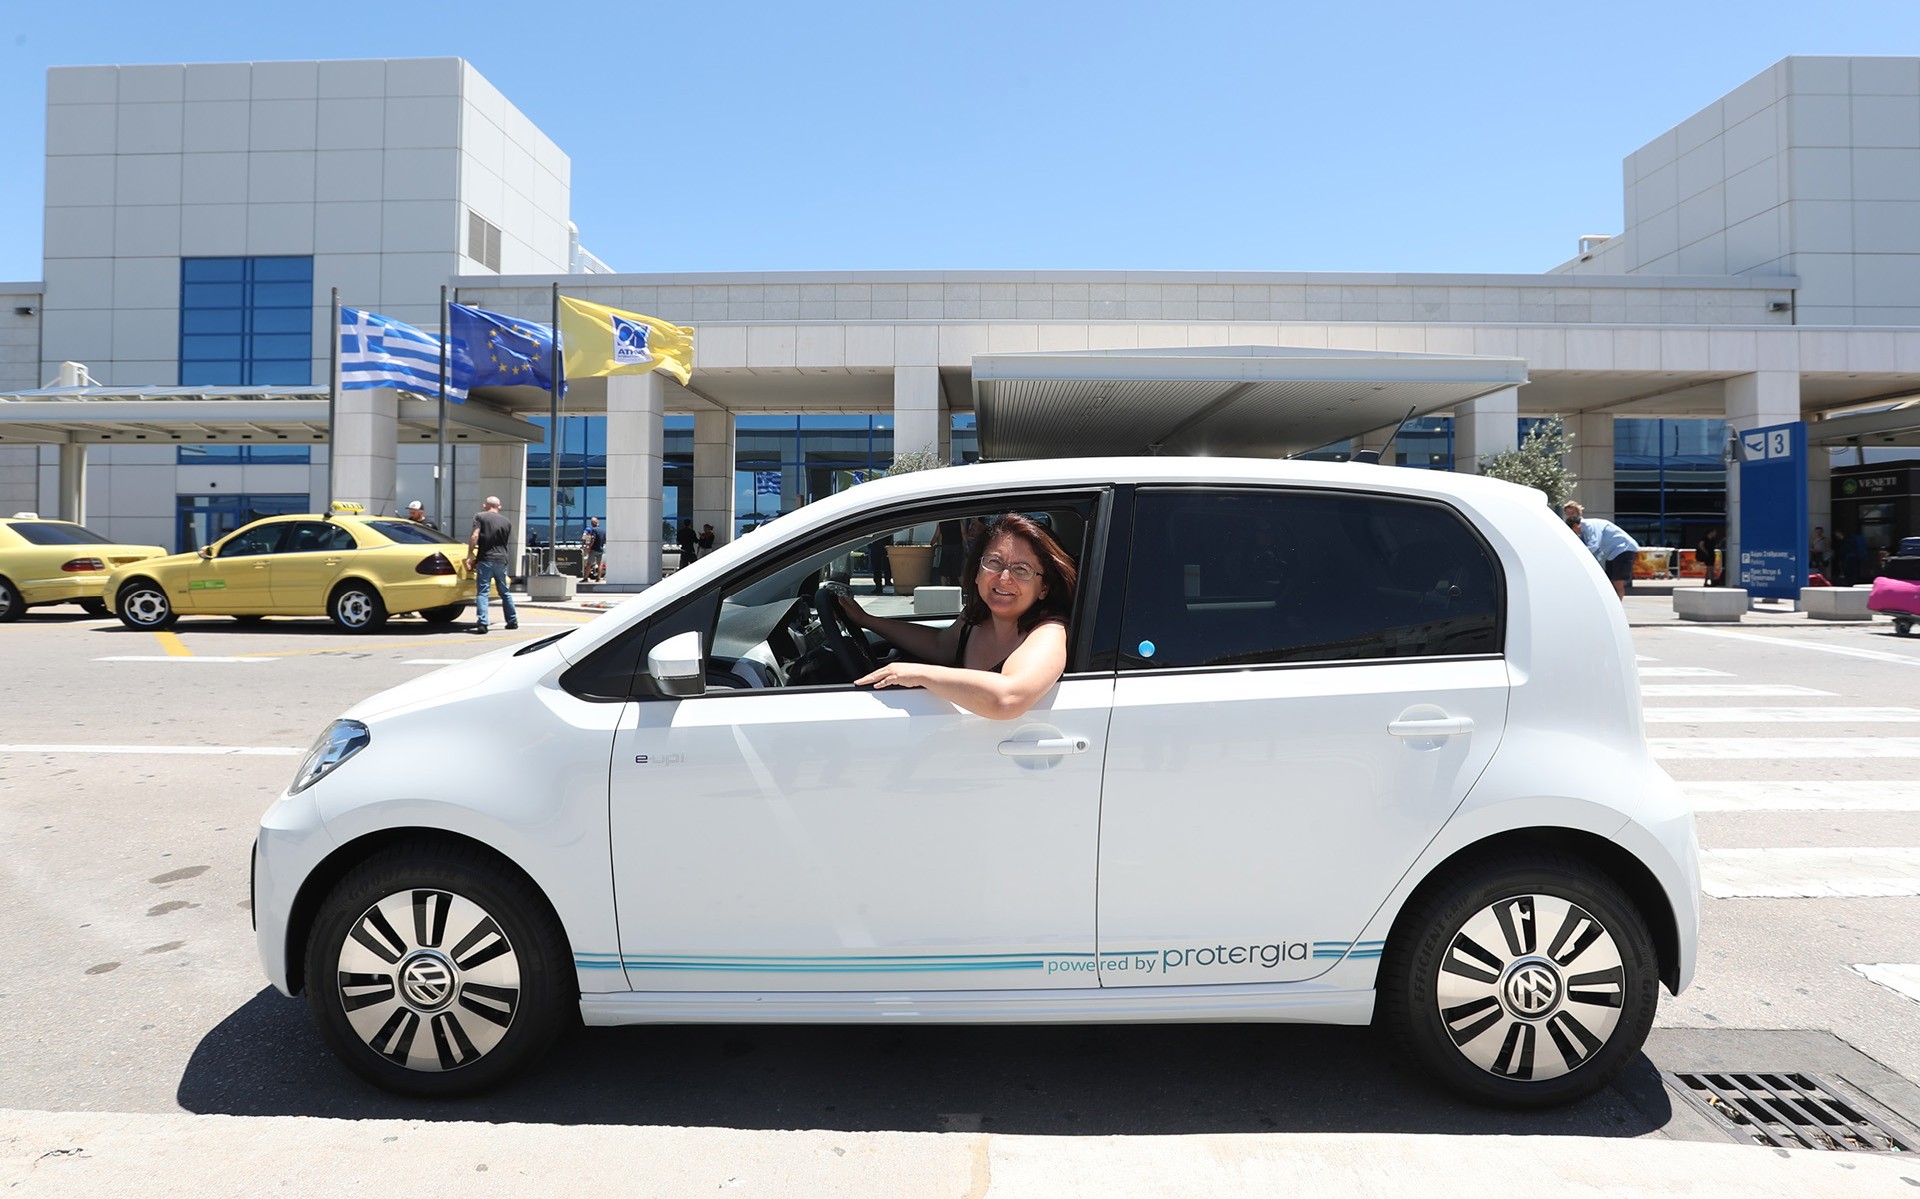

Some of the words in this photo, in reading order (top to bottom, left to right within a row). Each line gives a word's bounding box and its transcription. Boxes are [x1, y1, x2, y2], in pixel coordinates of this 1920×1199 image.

[1774, 434, 1784, 454] 3
[1858, 476, 1897, 488] VENETI
[1048, 957, 1128, 975] powered
[1135, 956, 1157, 973] by
